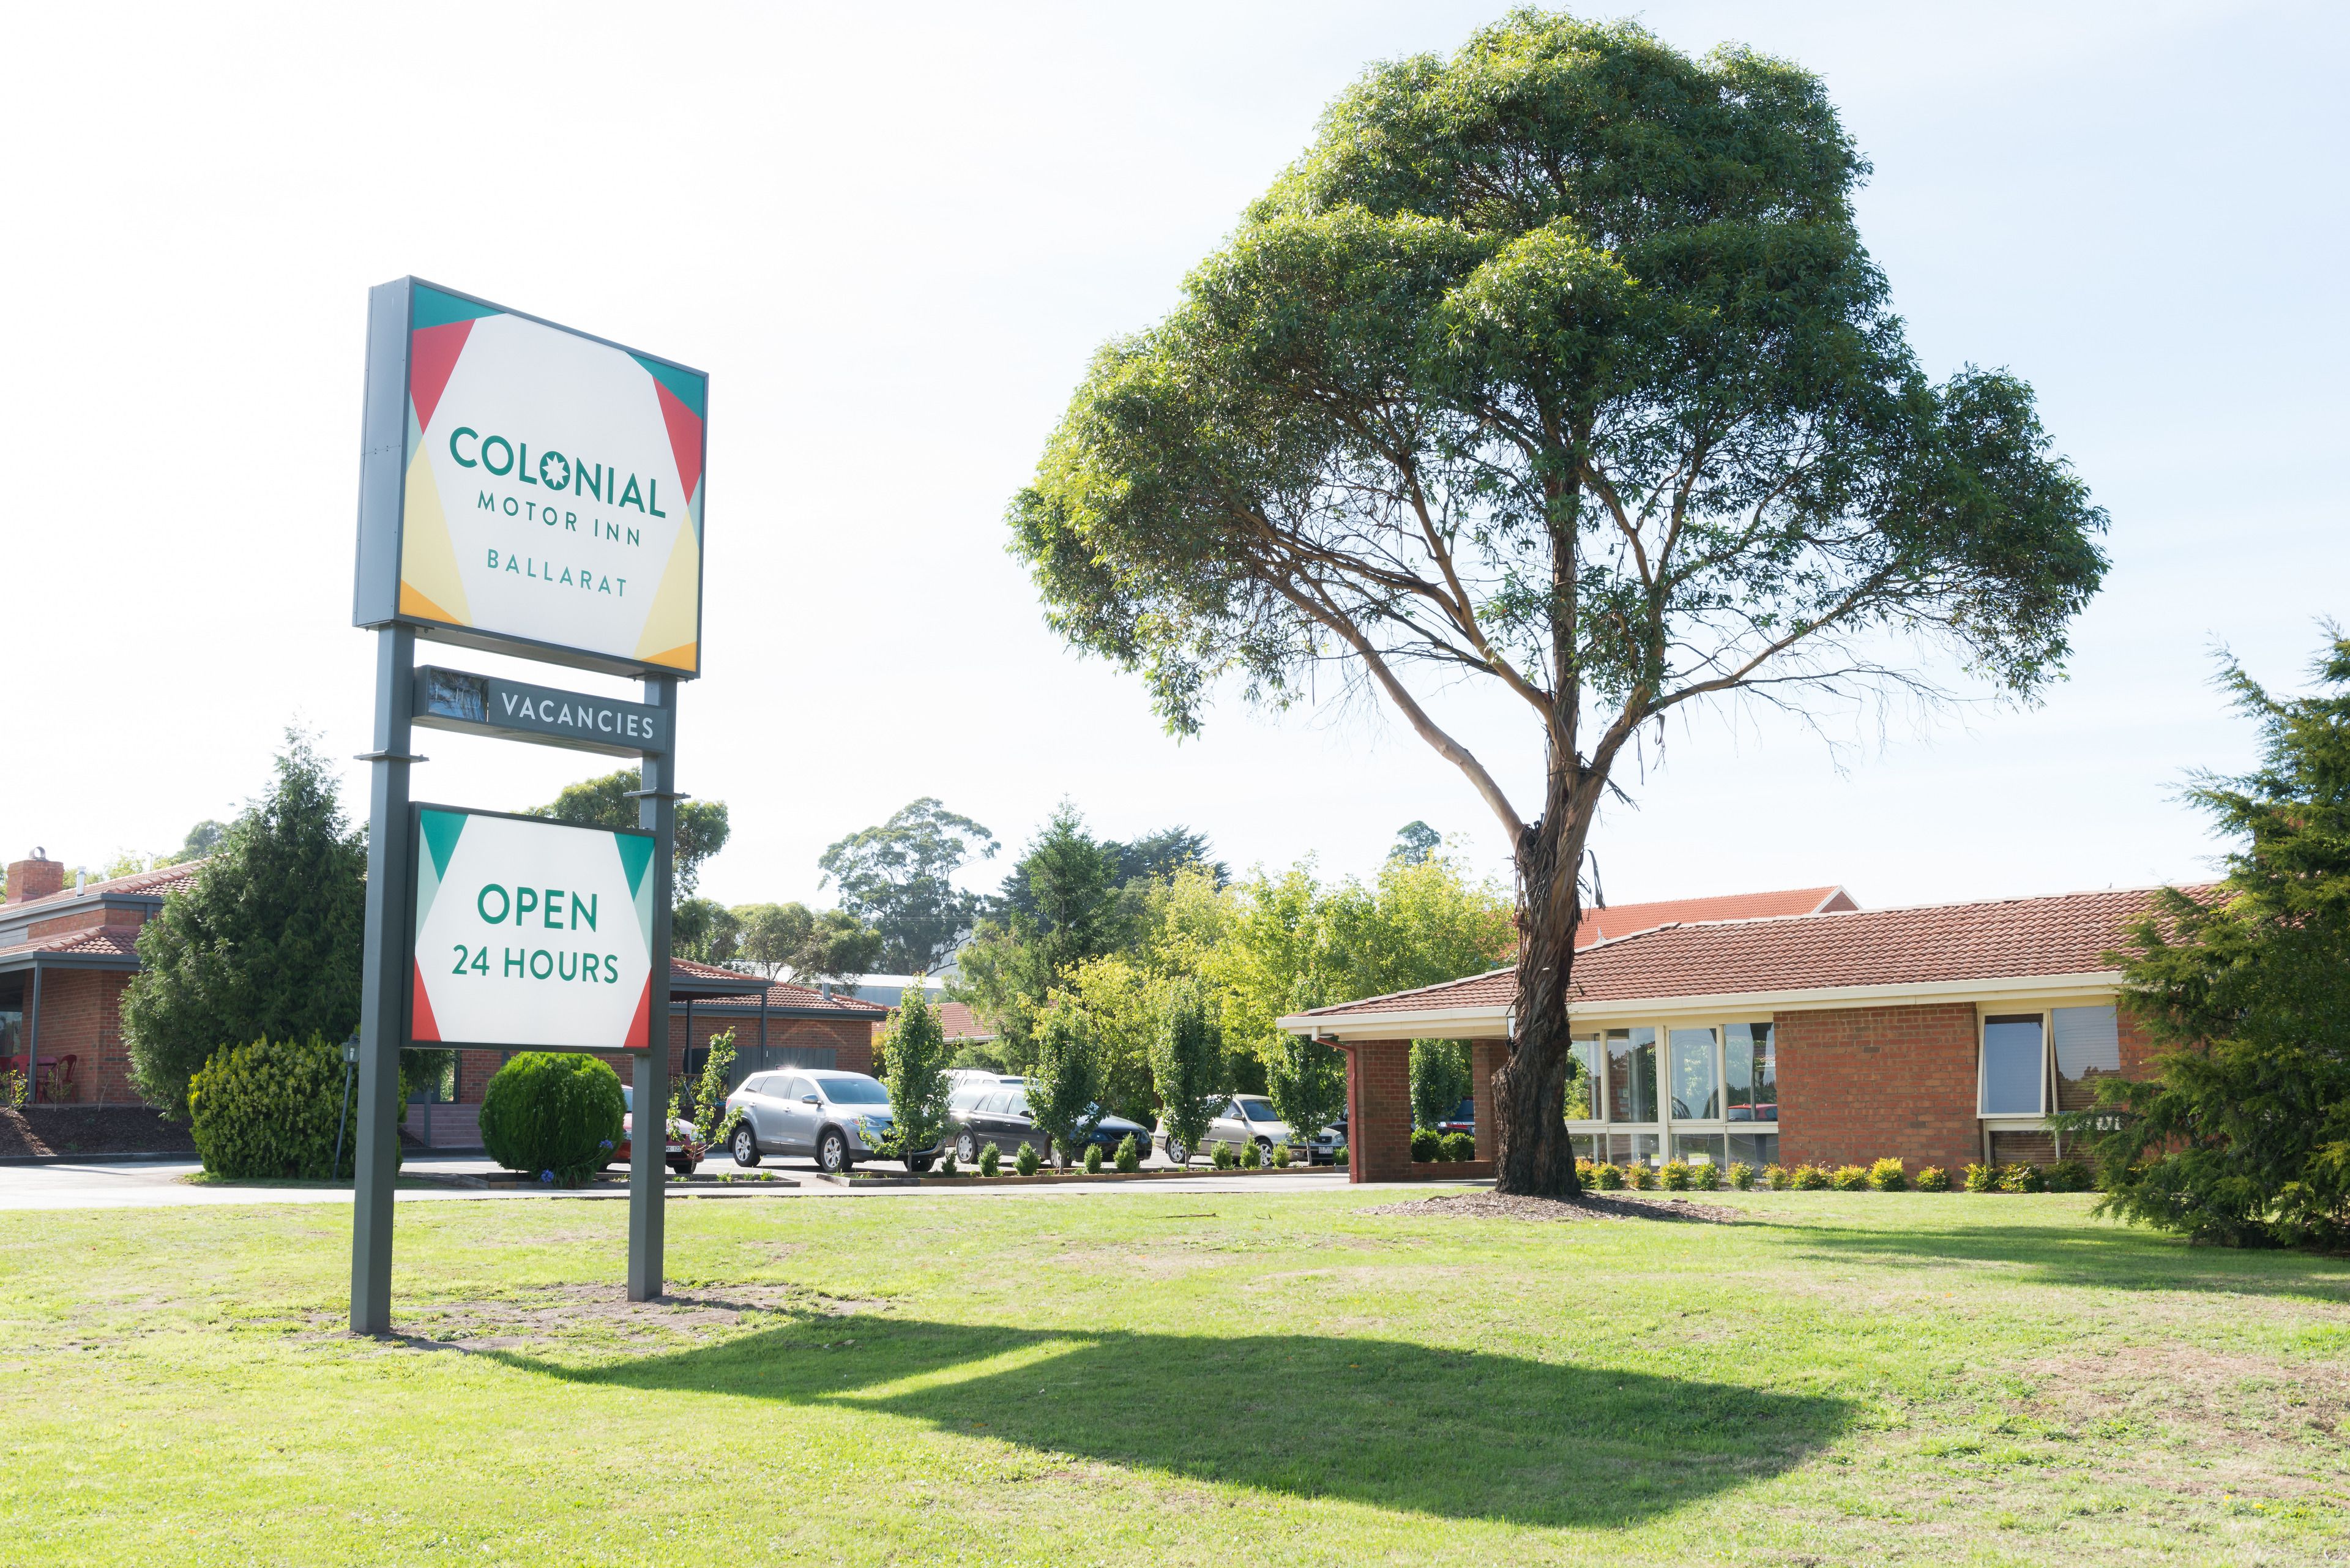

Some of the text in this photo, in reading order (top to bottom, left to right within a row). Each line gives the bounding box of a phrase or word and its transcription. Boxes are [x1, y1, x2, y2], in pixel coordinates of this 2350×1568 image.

[450, 427, 666, 518] COLONIAL
[478, 490, 640, 547] MOTOR INN
[488, 549, 627, 597] BALLARAT
[502, 693, 653, 739] VACANCIES
[478, 884, 597, 931] OPEN
[452, 944, 618, 984] 24 HOURS
